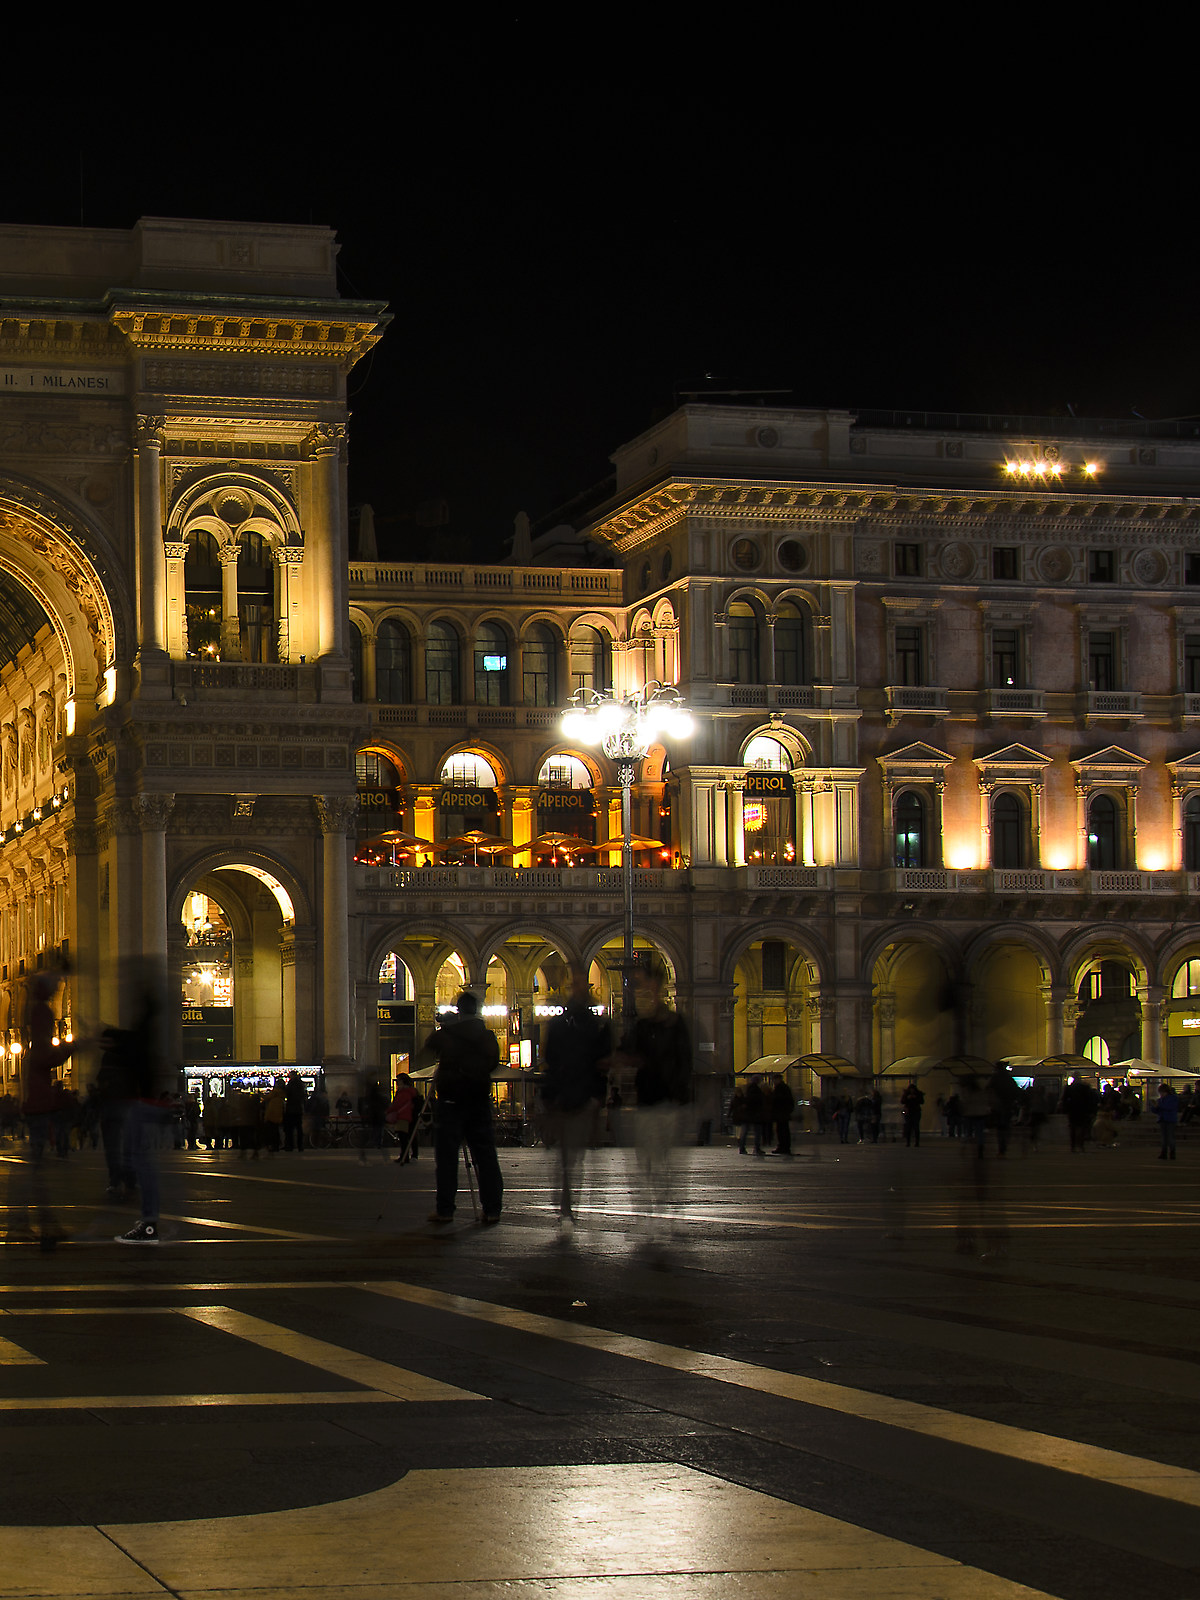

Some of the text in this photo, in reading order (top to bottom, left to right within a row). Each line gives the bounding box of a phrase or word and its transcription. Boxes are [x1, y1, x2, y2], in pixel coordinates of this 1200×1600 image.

[42, 376, 109, 389] MILANESI
[745, 777, 786, 790] PEROL
[441, 791, 489, 806] APEROL
[537, 792, 585, 807] APEROL
